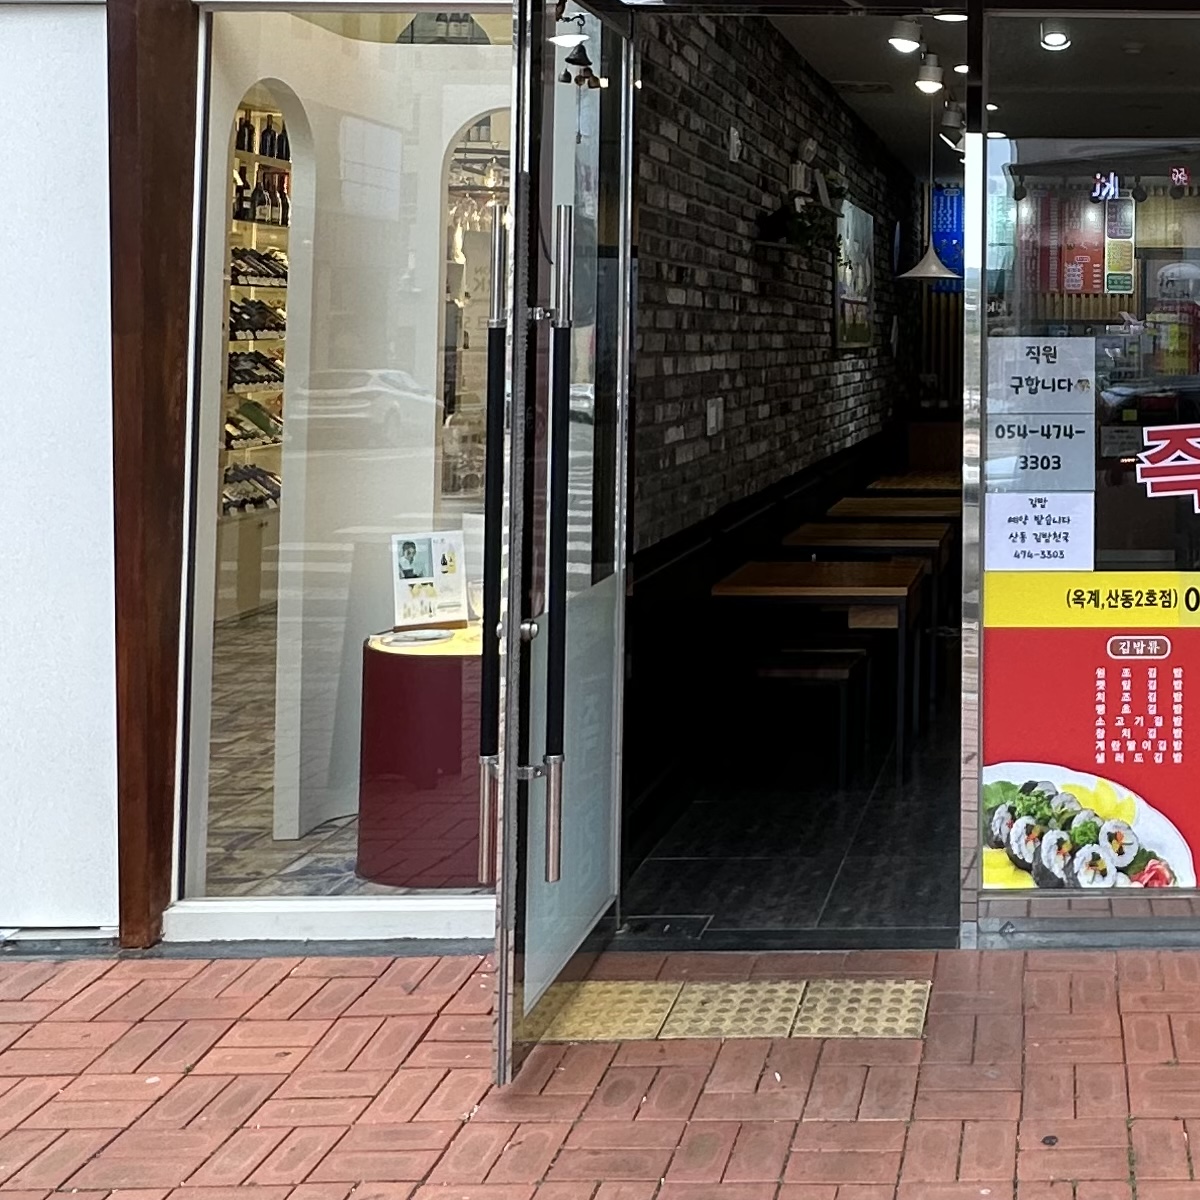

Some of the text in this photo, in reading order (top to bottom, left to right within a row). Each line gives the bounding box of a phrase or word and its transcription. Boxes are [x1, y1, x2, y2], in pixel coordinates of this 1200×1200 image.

[1025, 345, 1058, 364] 직원
[1010, 376, 1073, 395] 구합니다
[995, 424, 1086, 440] 054-474-
[1019, 455, 1062, 471] 3303
[1028, 497, 1048, 508] 김밥
[1007, 514, 1071, 525] 예약 받습니다
[1008, 531, 1070, 543] 산동 김밥천국
[1013, 550, 1065, 559] 474-3303
[1066, 588, 1178, 609] (옥계,산동2호점)
[1118, 640, 1161, 655] 김밥류
